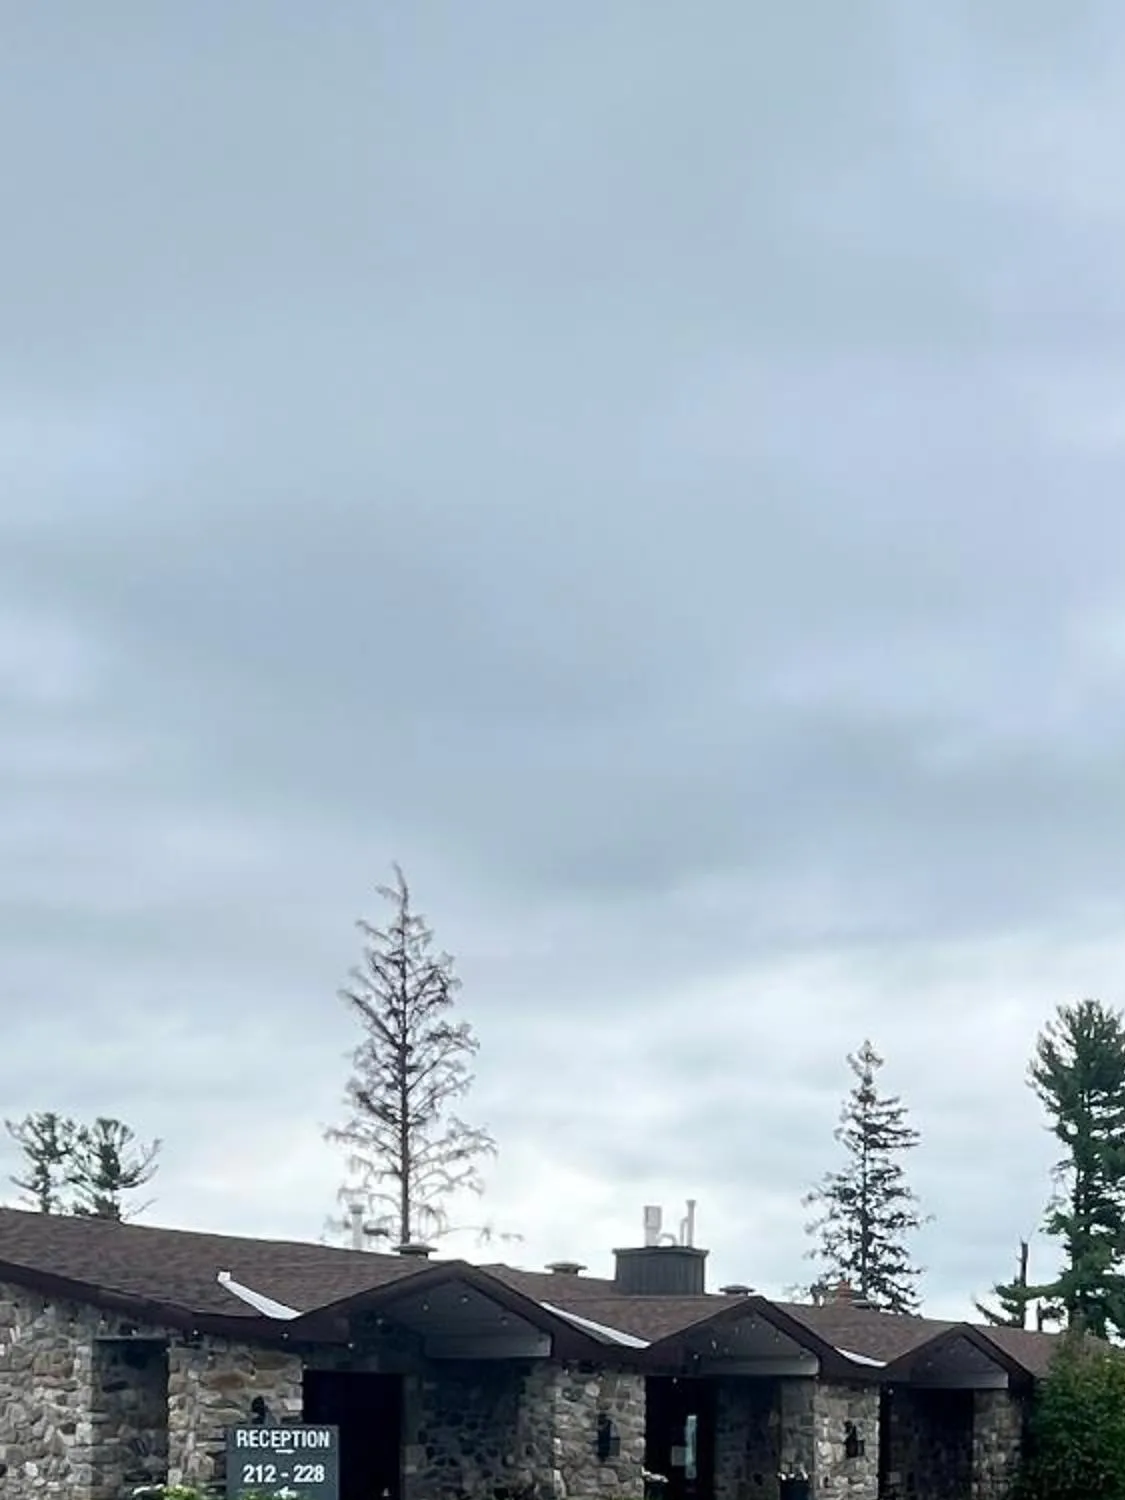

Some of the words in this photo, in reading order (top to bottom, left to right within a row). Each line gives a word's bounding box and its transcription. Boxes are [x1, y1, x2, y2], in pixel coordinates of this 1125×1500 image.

[236, 1429, 330, 1448] RECEPTION
[243, 1464, 277, 1483] 212
[293, 1464, 325, 1483] 228
